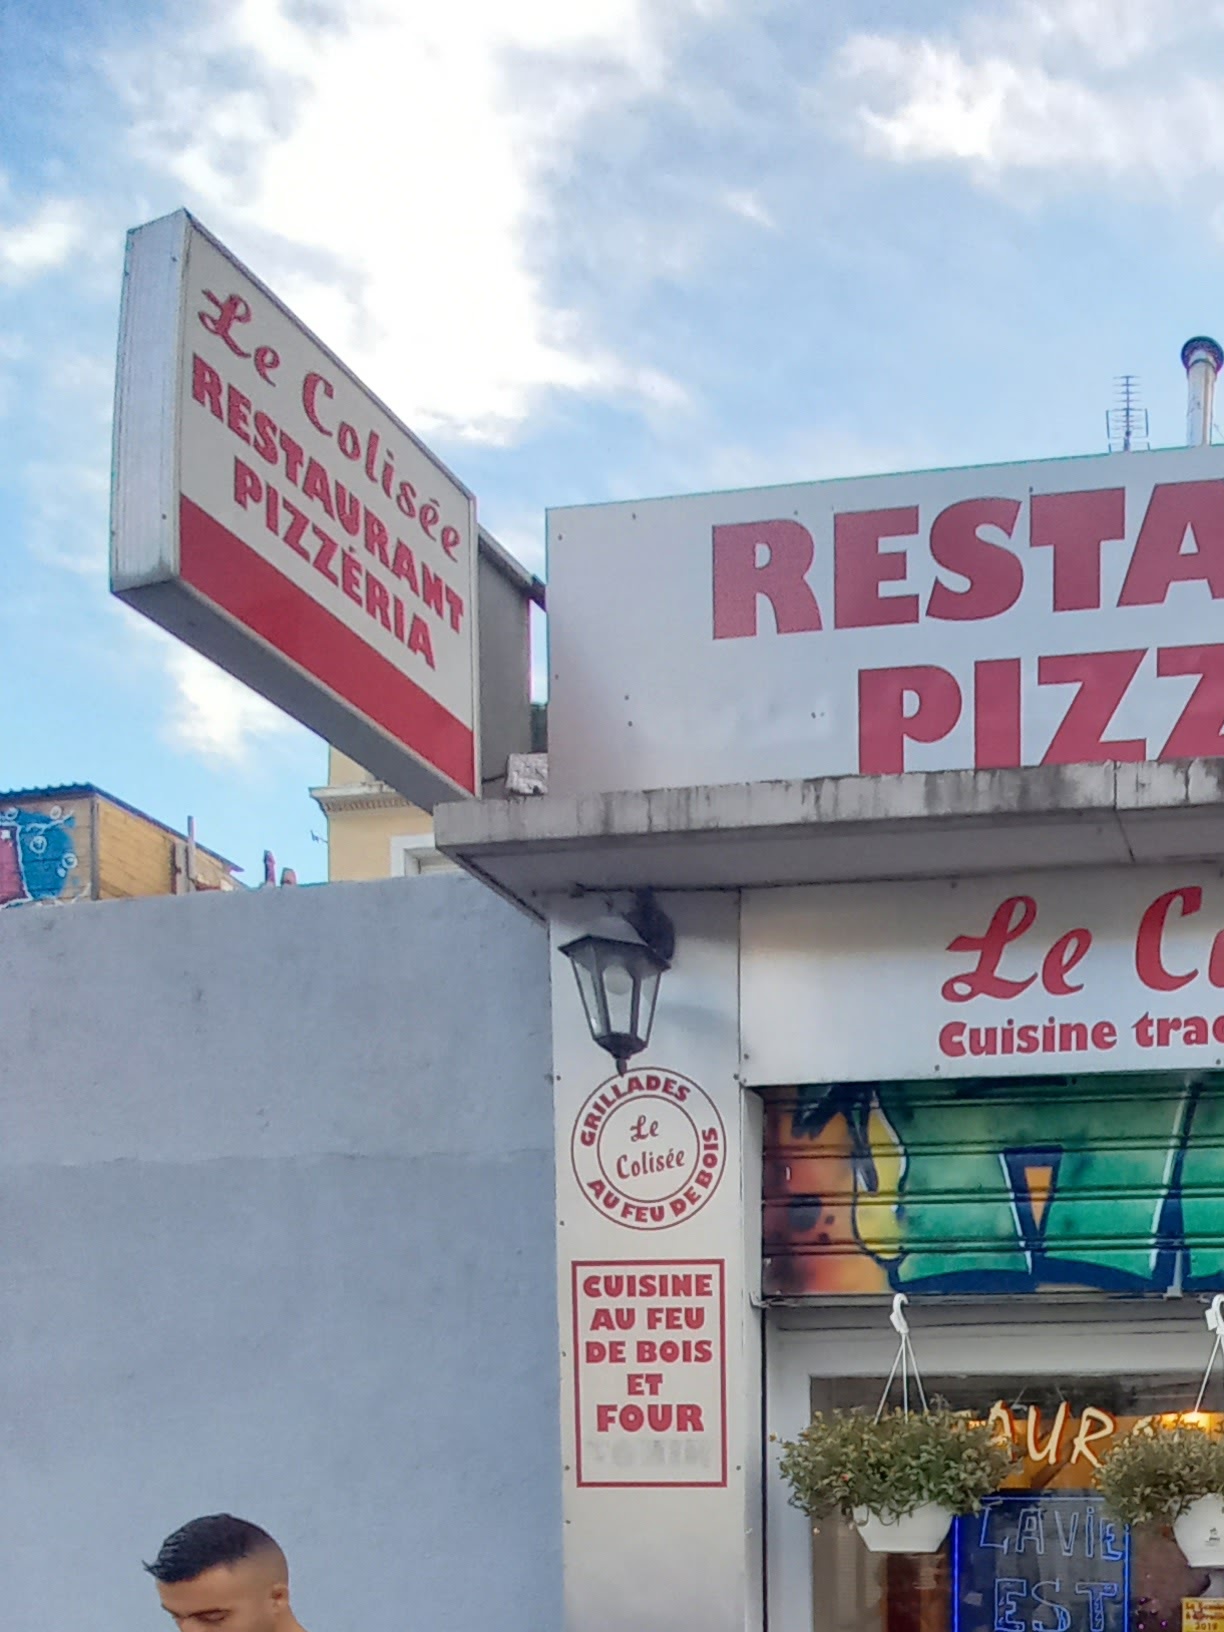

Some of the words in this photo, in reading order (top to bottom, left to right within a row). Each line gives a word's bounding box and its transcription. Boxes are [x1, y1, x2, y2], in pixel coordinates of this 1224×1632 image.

[198, 289, 282, 388] Le
[302, 371, 461, 564] Colisée
[192, 351, 465, 634] RESTAURANT
[940, 895, 1093, 1003] Le
[938, 1015, 1118, 1058] Cuisine
[580, 1074, 691, 1147] GRILLADES
[630, 1114, 660, 1142] Le
[586, 1178, 621, 1210] AU
[620, 1201, 665, 1223] FEU
[669, 1186, 702, 1218] DE
[694, 1127, 720, 1190] BOIS
[616, 1147, 686, 1180] Colisée
[582, 1273, 714, 1298] CUISINE
[589, 1307, 637, 1331] AU
[646, 1306, 706, 1331] FEU
[584, 1340, 627, 1364] DE
[635, 1339, 713, 1364] BOIS
[626, 1372, 664, 1397] ET
[596, 1403, 705, 1433] FOUR
[979, 1501, 1044, 1555] LA
[994, 1577, 1118, 1632] EST
